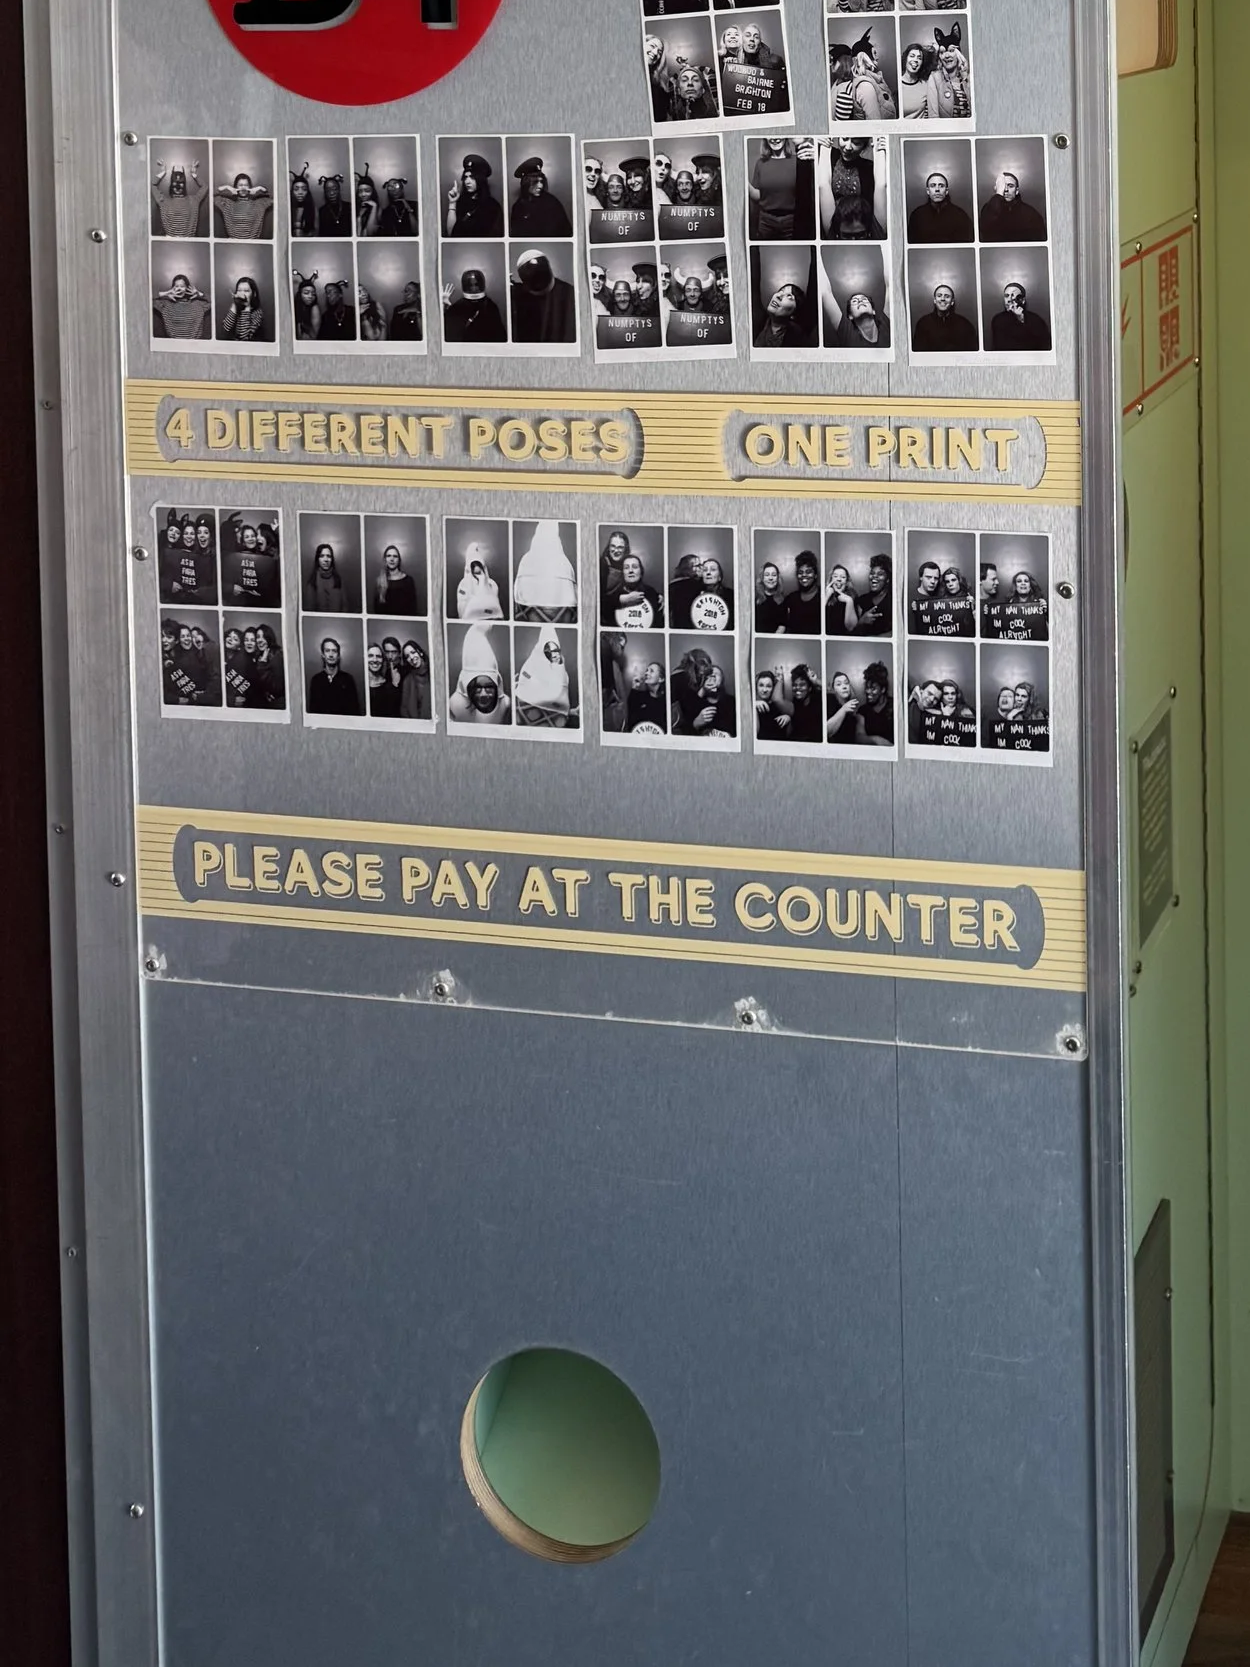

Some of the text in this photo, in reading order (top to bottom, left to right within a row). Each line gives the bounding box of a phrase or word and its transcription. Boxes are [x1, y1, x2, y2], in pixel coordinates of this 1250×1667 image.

[735, 83, 772, 99] BRIGHTON
[736, 98, 766, 112] FEB 18
[601, 211, 646, 221] NUMPTYS
[670, 208, 715, 217] NUMPTYS
[618, 225, 630, 236] OF
[687, 221, 700, 231] OF
[608, 318, 653, 328] NUMPTYS
[680, 314, 725, 325] NUMPTYS
[625, 332, 637, 342] OF
[697, 328, 709, 339] OF
[164, 407, 631, 465] 4 DIFFERENT POSES
[745, 424, 1020, 473] ONE PRINT
[933, 601, 945, 611] NAN
[1005, 605, 1018, 614] NAN
[940, 718, 955, 730] NAN
[1010, 723, 1024, 734] NAN
[193, 841, 1021, 952] PLEASE PAY AT THE COUNTER
